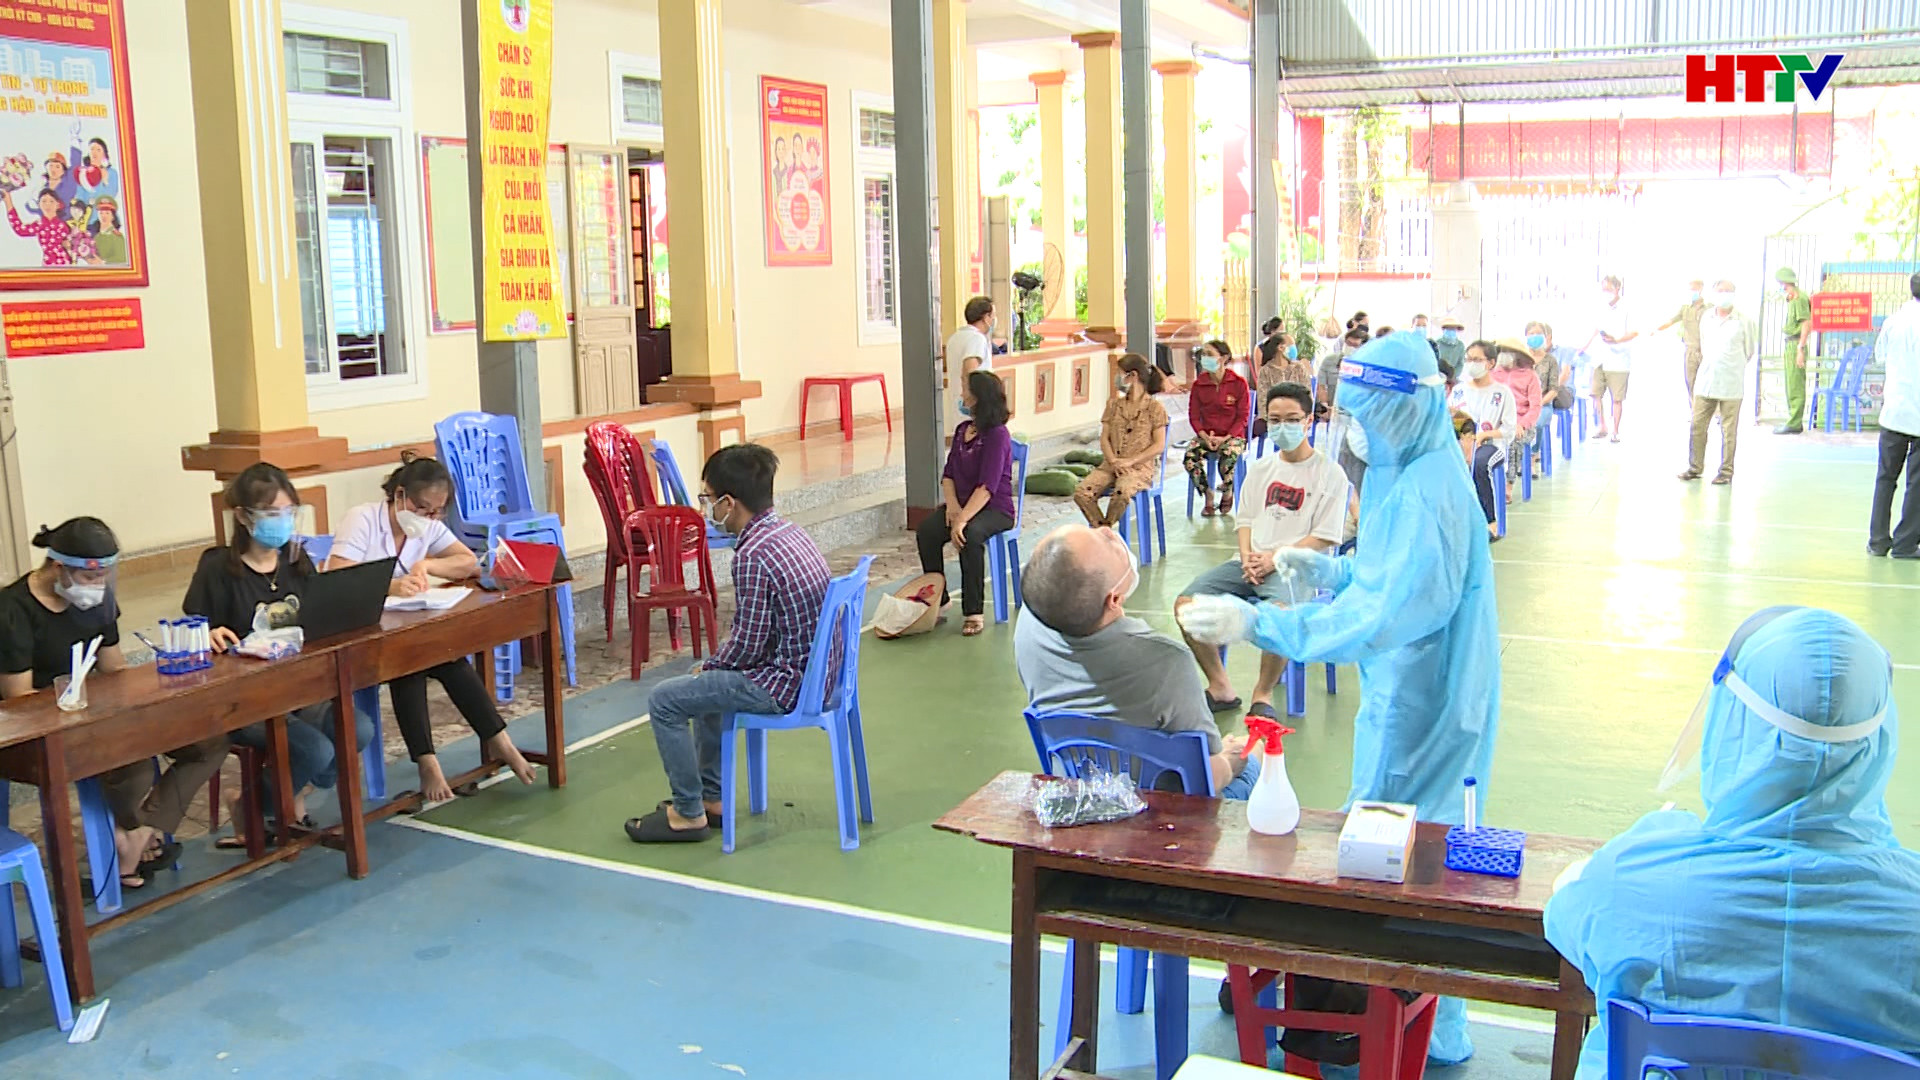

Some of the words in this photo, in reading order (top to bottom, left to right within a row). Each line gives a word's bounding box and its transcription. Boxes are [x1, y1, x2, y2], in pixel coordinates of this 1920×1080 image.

[516, 112, 534, 133] CAO
[499, 141, 526, 167] TRÁCH
[500, 248, 514, 267] GIA
[500, 278, 522, 301] TOÀN
